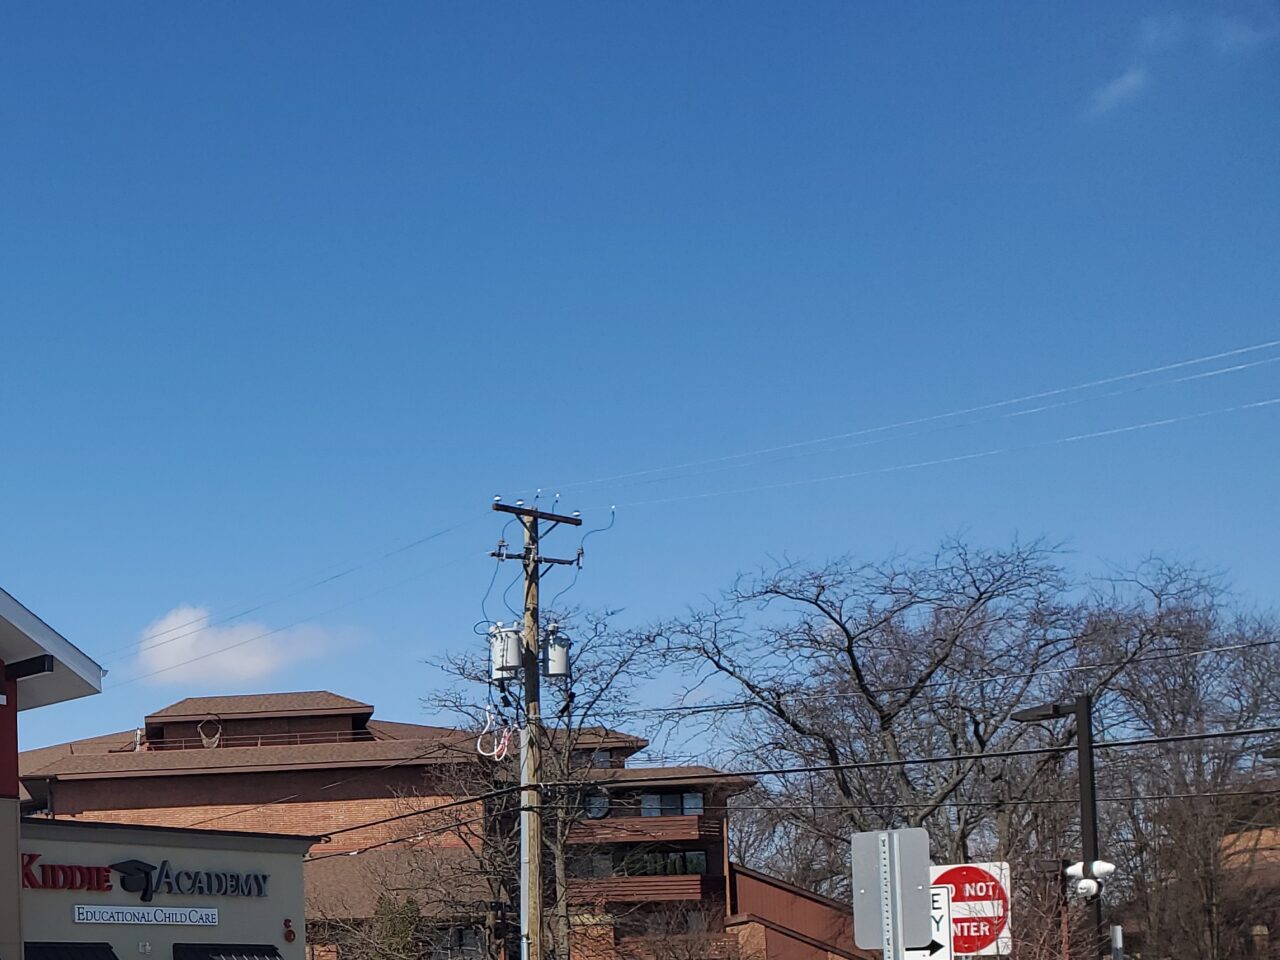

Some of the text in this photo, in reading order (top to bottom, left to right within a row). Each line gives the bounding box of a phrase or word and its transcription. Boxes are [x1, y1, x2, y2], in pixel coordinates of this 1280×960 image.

[21, 853, 270, 897] KIDDIE ACADEMY
[965, 882, 995, 896] NOT
[77, 907, 217, 924] EDUCATIONAL CHILD CARE
[953, 922, 990, 936] NTER
